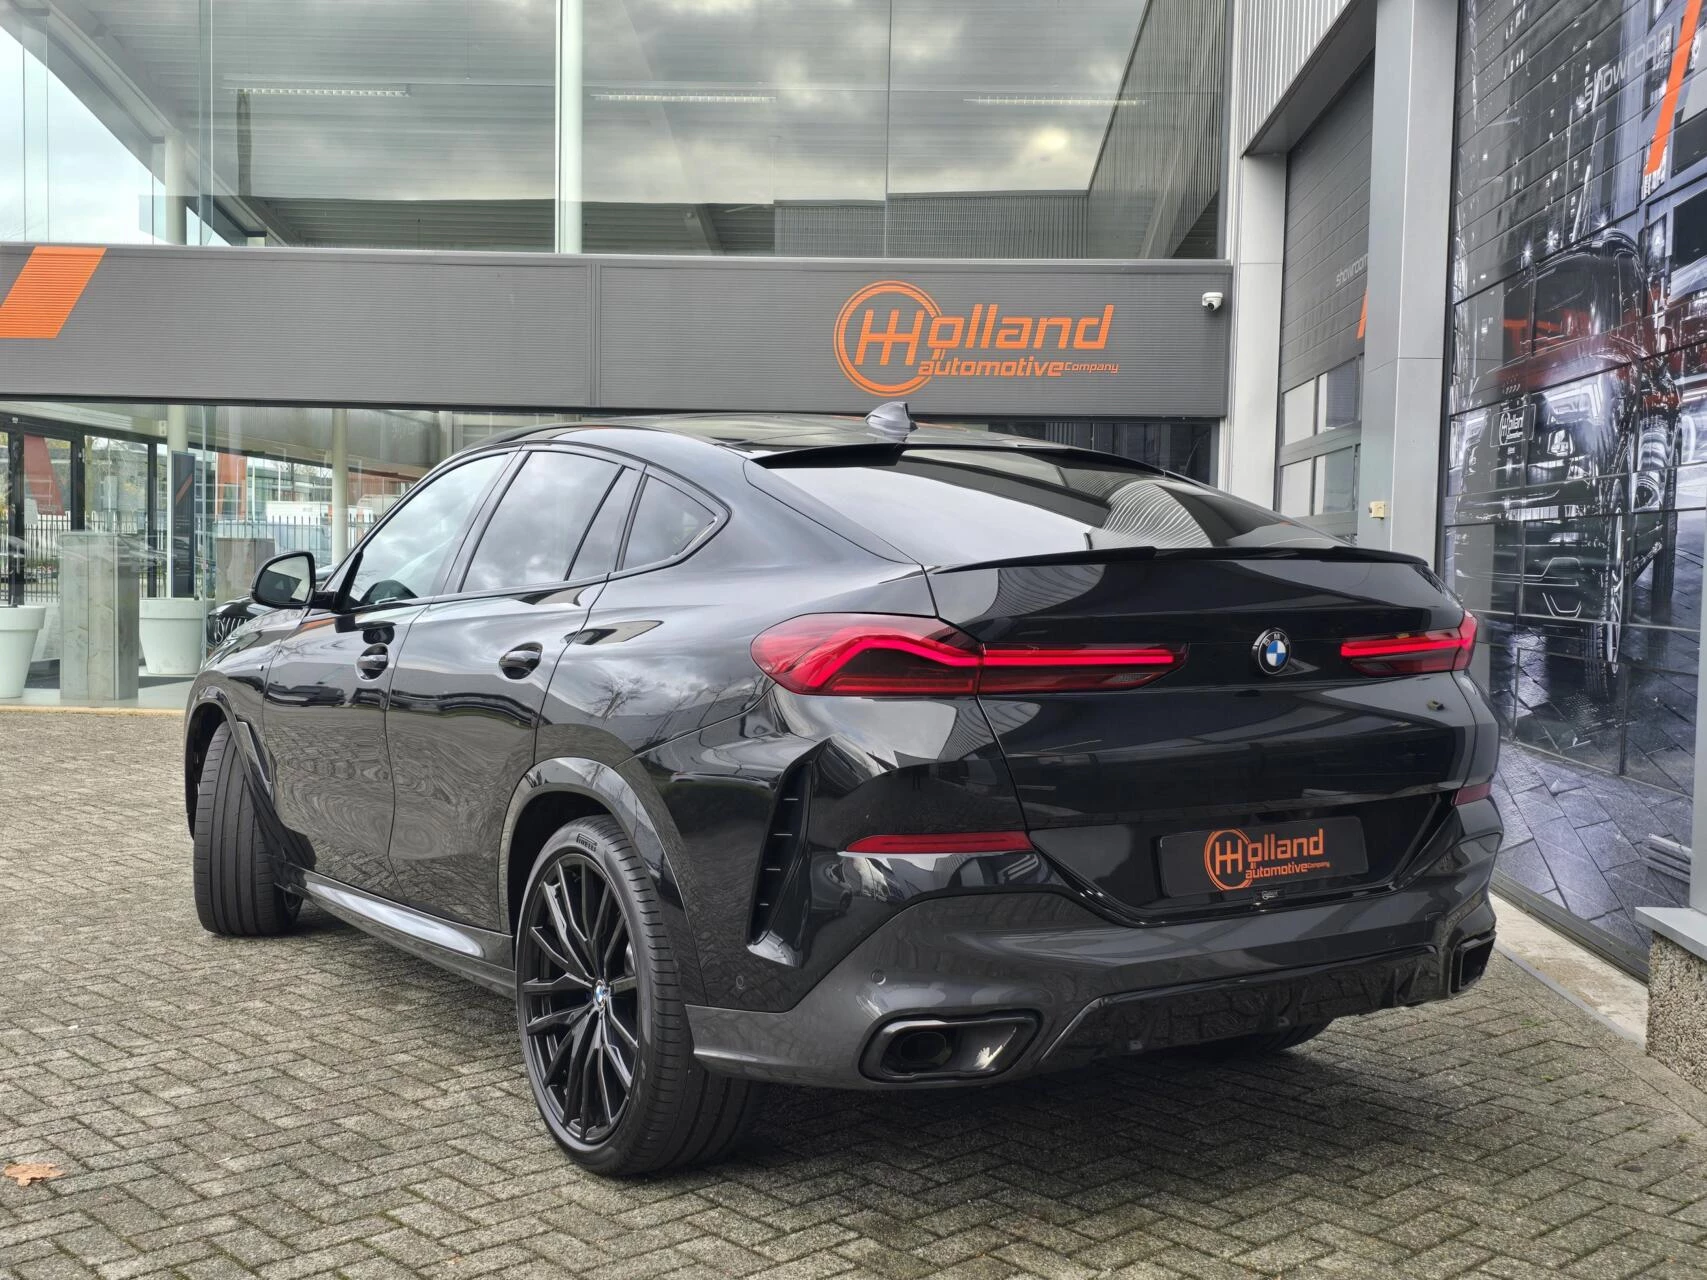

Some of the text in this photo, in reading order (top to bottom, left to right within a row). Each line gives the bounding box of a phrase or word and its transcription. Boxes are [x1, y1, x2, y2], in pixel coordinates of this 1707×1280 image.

[855, 303, 1115, 366] Holland
[918, 355, 1120, 377] automotive Company
[1215, 828, 1324, 876] Holland
[1245, 862, 1308, 879] automotive
